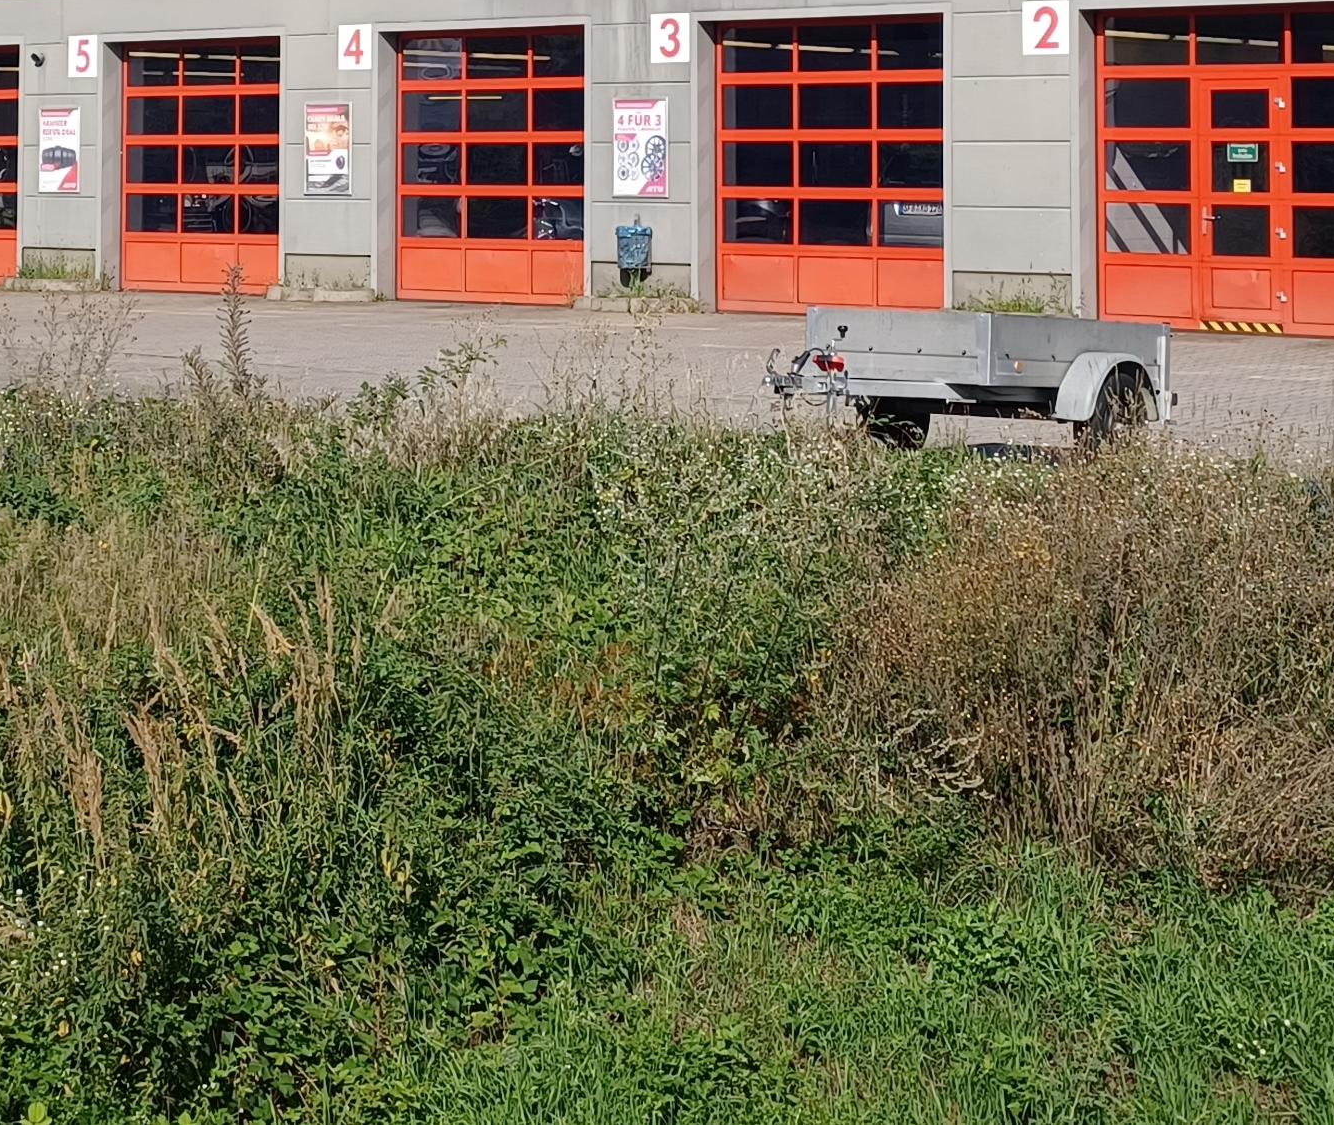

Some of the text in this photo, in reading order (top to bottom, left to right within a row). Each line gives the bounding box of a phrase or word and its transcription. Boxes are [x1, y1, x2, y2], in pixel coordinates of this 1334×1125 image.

[660, 18, 681, 58] 3
[1033, 6, 1060, 49] 2
[76, 39, 90, 73] 5
[343, 29, 364, 65] 4
[617, 111, 662, 126] 4 FÜR 3
